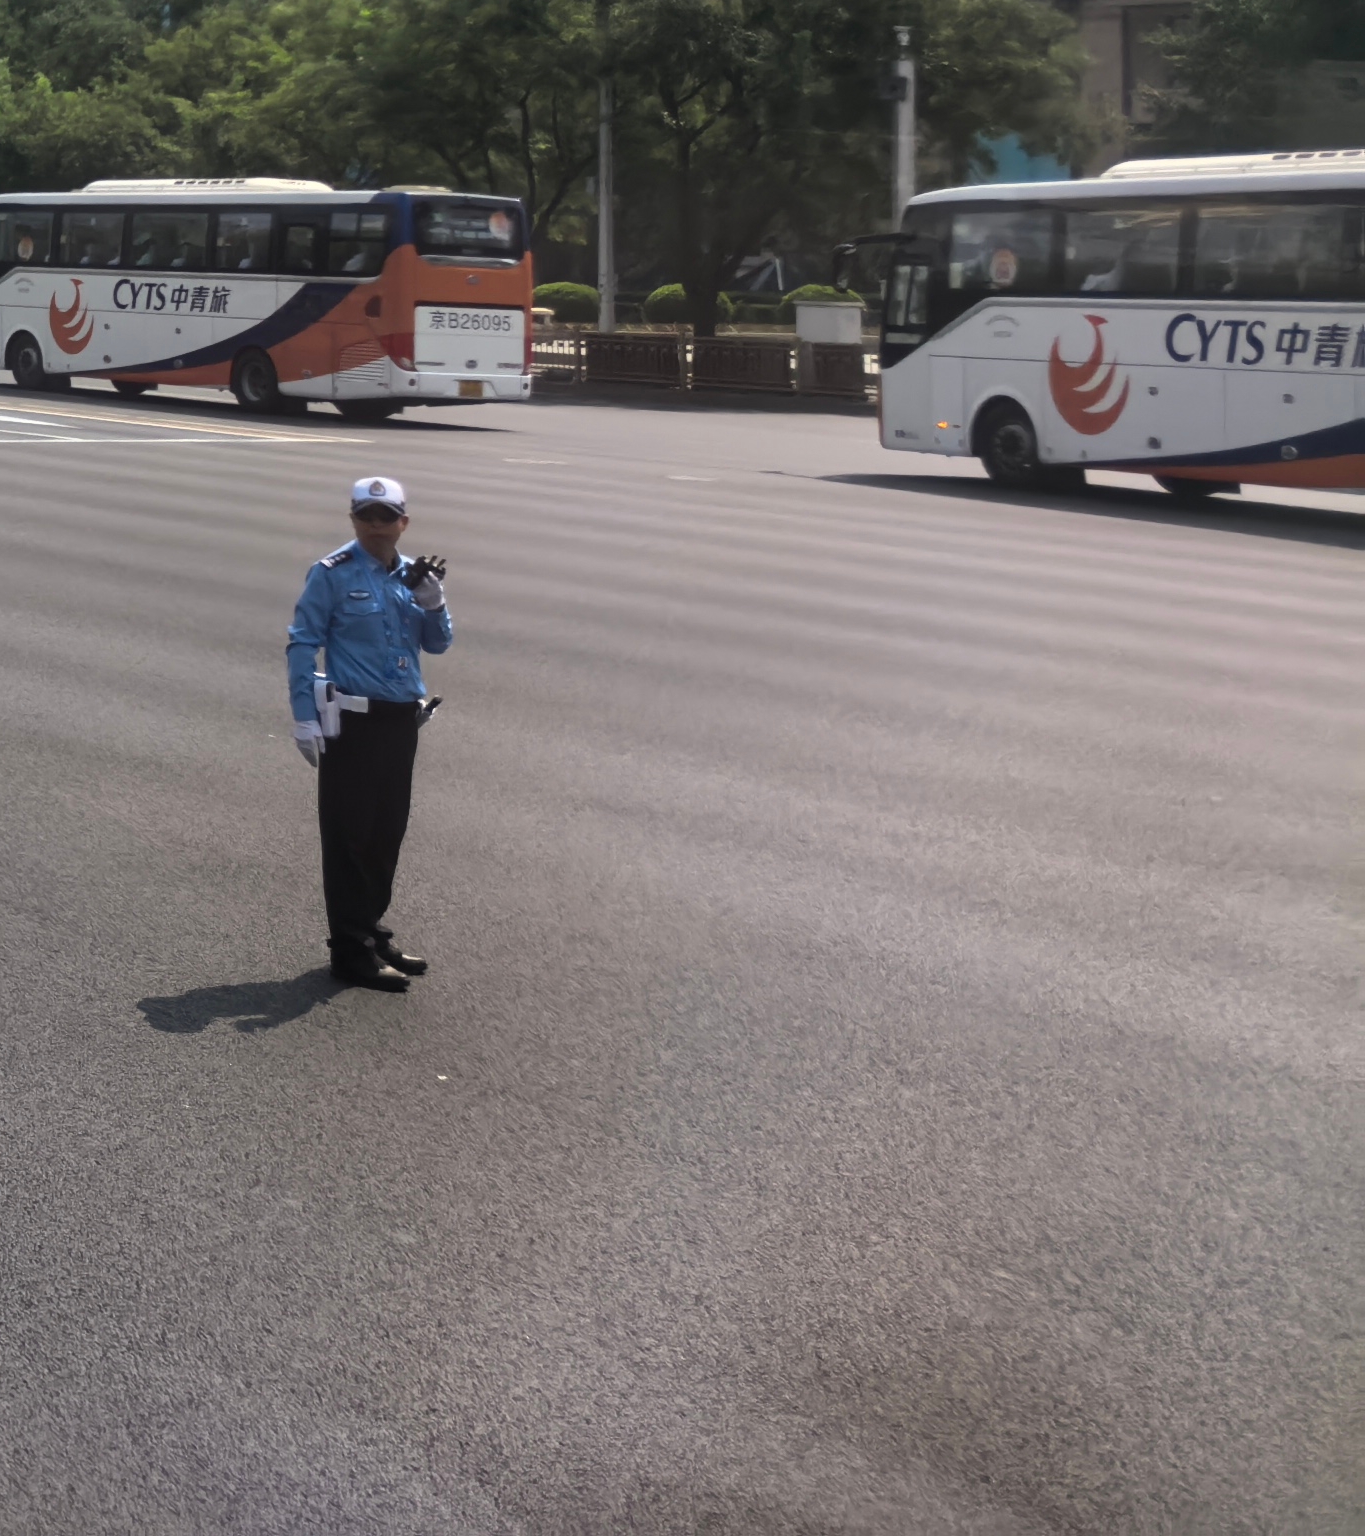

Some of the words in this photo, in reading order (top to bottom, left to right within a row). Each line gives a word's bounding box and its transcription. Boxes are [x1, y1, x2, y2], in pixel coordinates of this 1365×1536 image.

[113, 279, 166, 311] CYTS
[170, 284, 231, 313] 中青旅
[429, 311, 511, 331] 京B26095
[1165, 313, 1267, 365] CYTS
